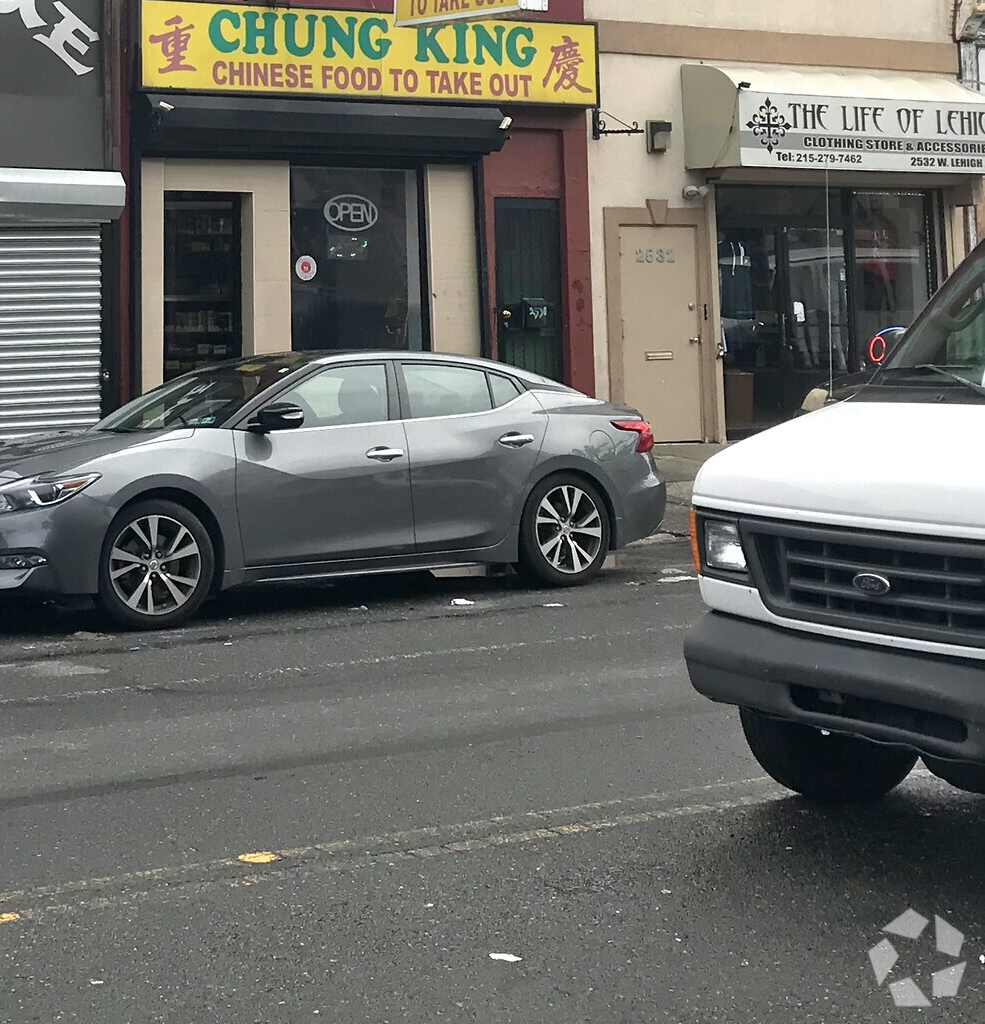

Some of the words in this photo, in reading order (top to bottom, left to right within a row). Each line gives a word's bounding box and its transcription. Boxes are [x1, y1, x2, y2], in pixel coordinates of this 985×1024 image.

[149, 15, 197, 74] 重
[208, 9, 392, 60] CHUNG
[414, 25, 537, 68] KING
[542, 35, 593, 93] 慶
[212, 61, 313, 89] CHINESE
[322, 65, 382, 91] FOOD
[389, 68, 419, 92] TO
[426, 70, 482, 95] TAKE
[489, 73, 532, 97] OUT
[788, 102, 829, 130] THE
[841, 105, 885, 133] LIFE
[897, 108, 924, 134] OF
[804, 137, 863, 149] CLOTHING
[866, 139, 903, 151] STORE
[906, 142, 914, 151] &
[796, 153, 862, 164] 215-279-7462
[911, 157, 935, 166] 2532
[937, 158, 949, 167] W.
[951, 158, 983, 167] LEHIGH
[329, 202, 372, 223] OPEN
[635, 248, 676, 264] 2532
